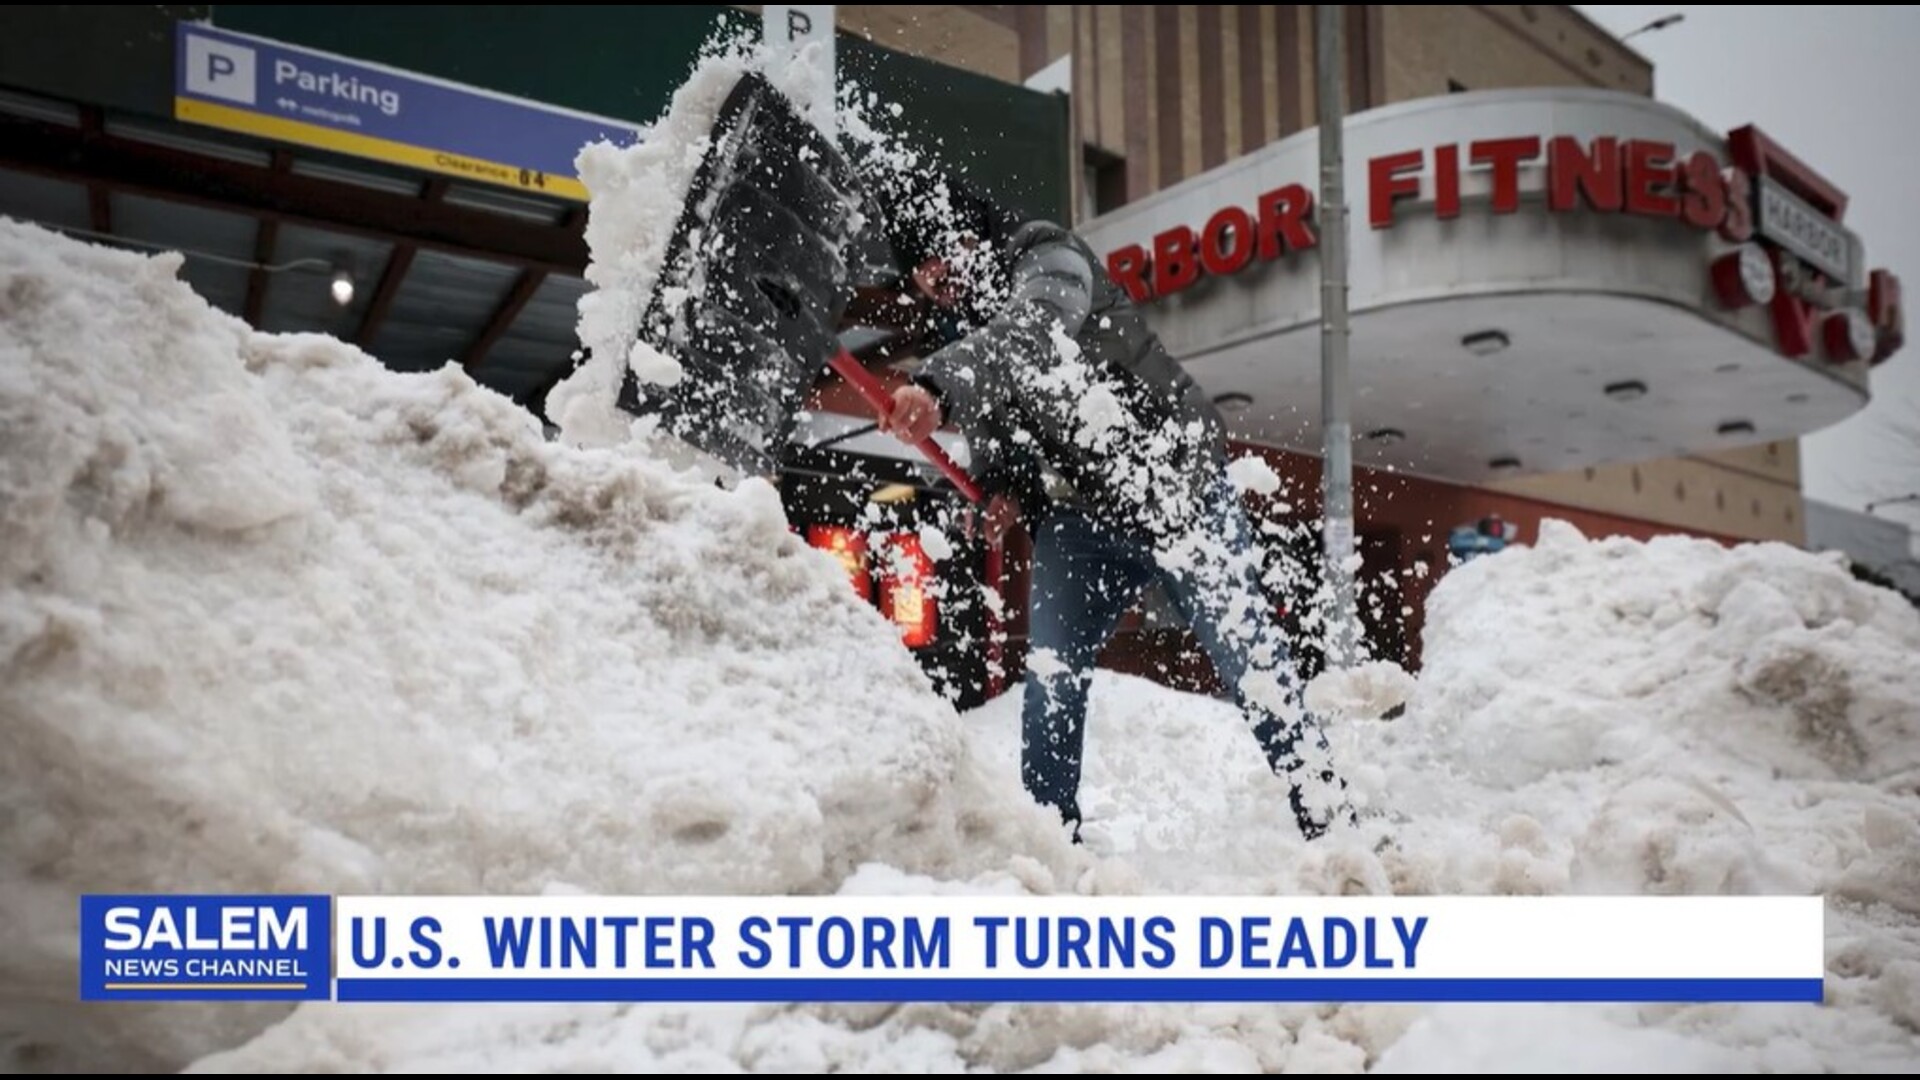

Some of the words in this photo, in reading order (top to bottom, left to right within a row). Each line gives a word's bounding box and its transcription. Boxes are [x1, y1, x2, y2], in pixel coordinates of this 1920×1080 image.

[207, 53, 235, 82] P
[274, 58, 400, 116] Parking
[434, 154, 510, 178] Clearance
[1367, 135, 1753, 243] FITNESS
[1765, 193, 1844, 264] HARBOR
